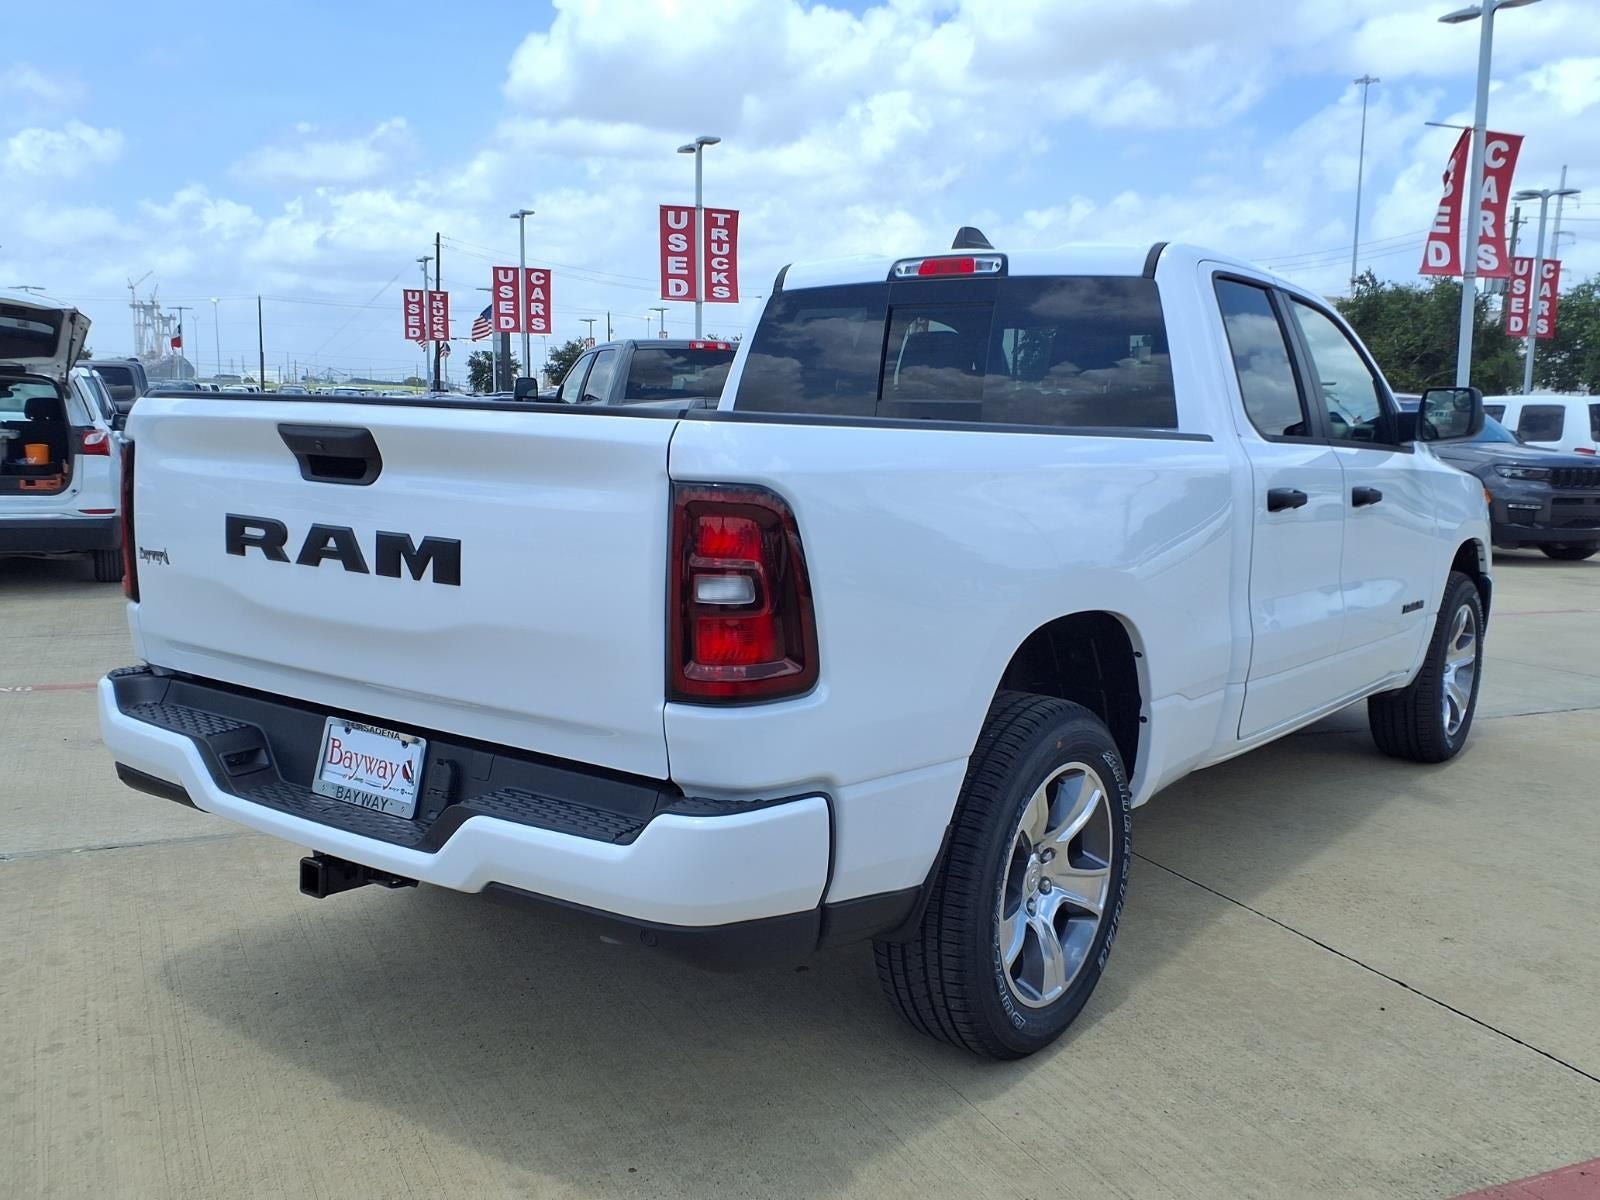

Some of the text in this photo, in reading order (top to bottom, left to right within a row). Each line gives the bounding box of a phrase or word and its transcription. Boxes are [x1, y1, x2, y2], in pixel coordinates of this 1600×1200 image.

[1476, 140, 1509, 270] CARS
[667, 210, 689, 296] USED
[711, 213, 731, 298] TRUCKS
[407, 291, 421, 338] USED
[432, 293, 445, 339] TRUCKS
[498, 270, 516, 329] USED
[530, 272, 546, 331] CARS
[1509, 260, 1529, 333] USED
[1536, 263, 1555, 334] CARS
[225, 512, 462, 587] RAM
[327, 737, 400, 790] Bayway
[335, 786, 390, 812] BAYWAY
